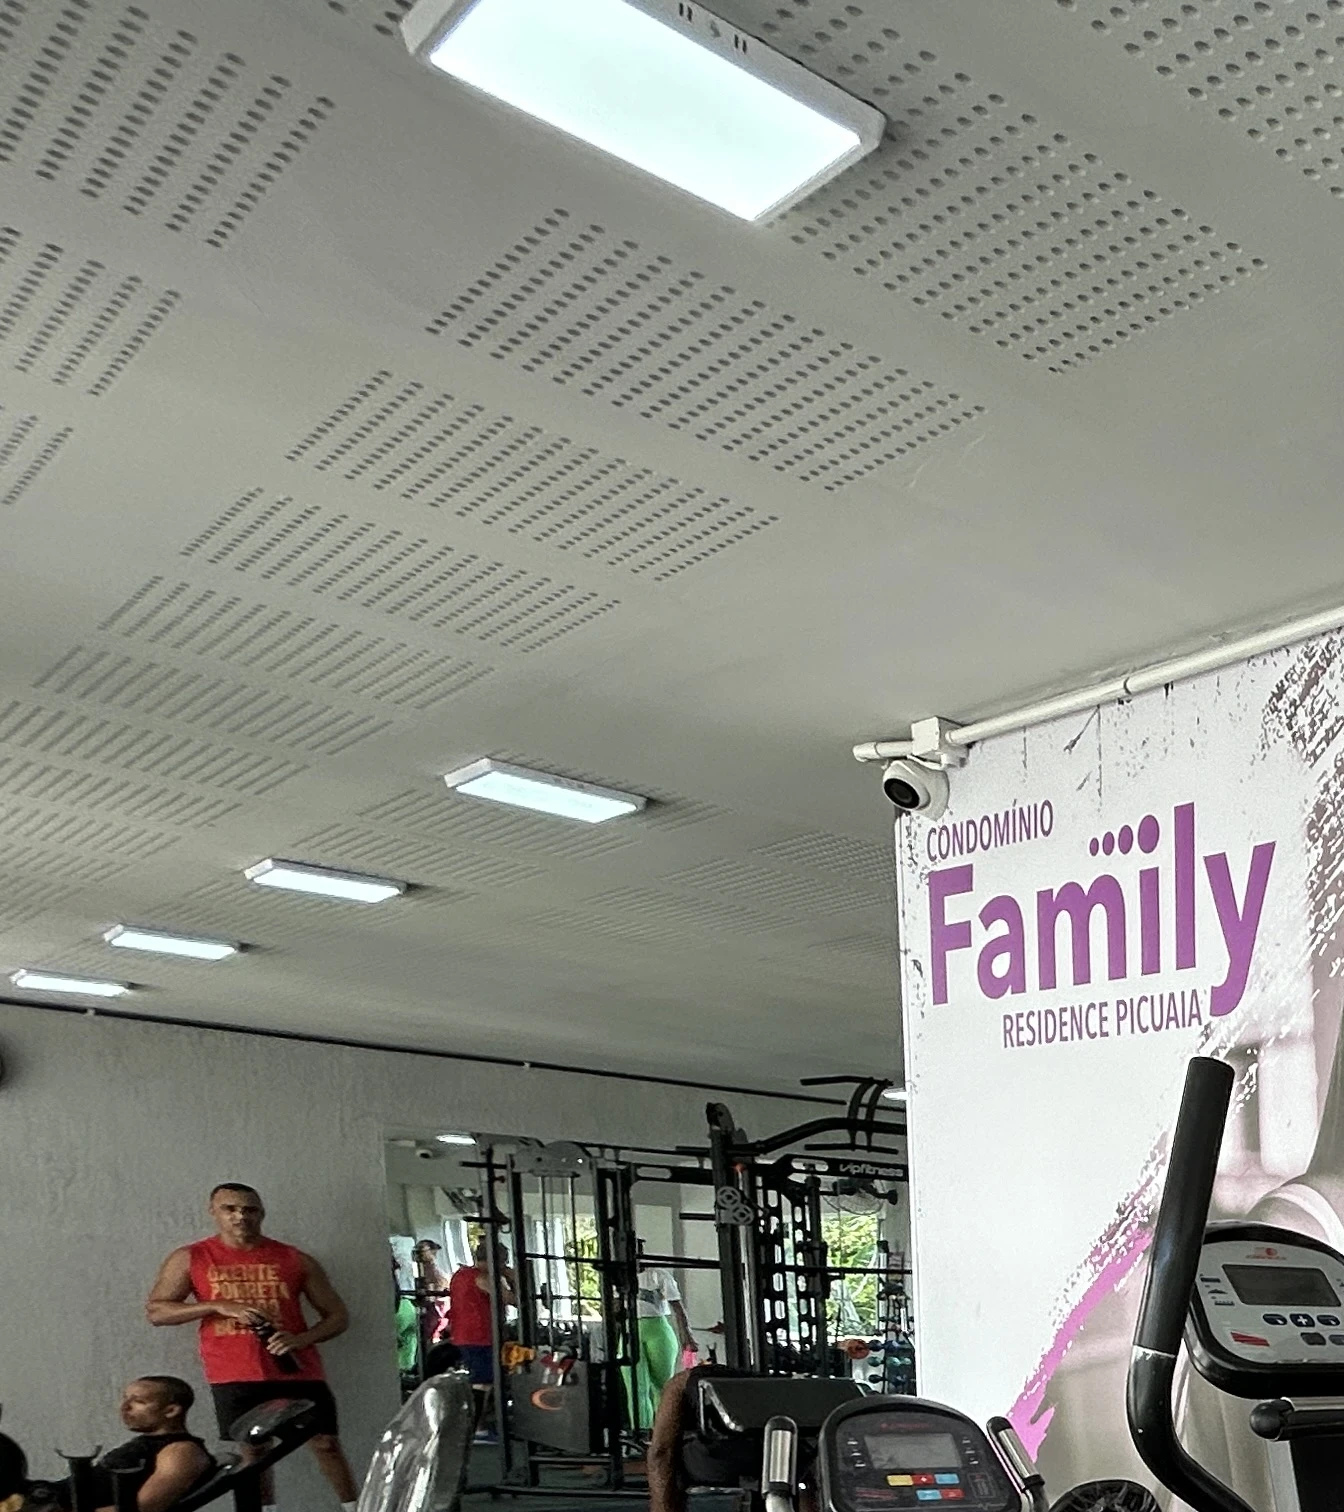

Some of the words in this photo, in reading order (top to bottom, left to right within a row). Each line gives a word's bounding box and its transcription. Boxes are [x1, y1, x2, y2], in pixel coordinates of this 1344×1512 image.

[927, 800, 1054, 862] CONDOMÍNIO
[927, 802, 1277, 1017] Family
[1003, 1001, 1109, 1049] RESIDENCE
